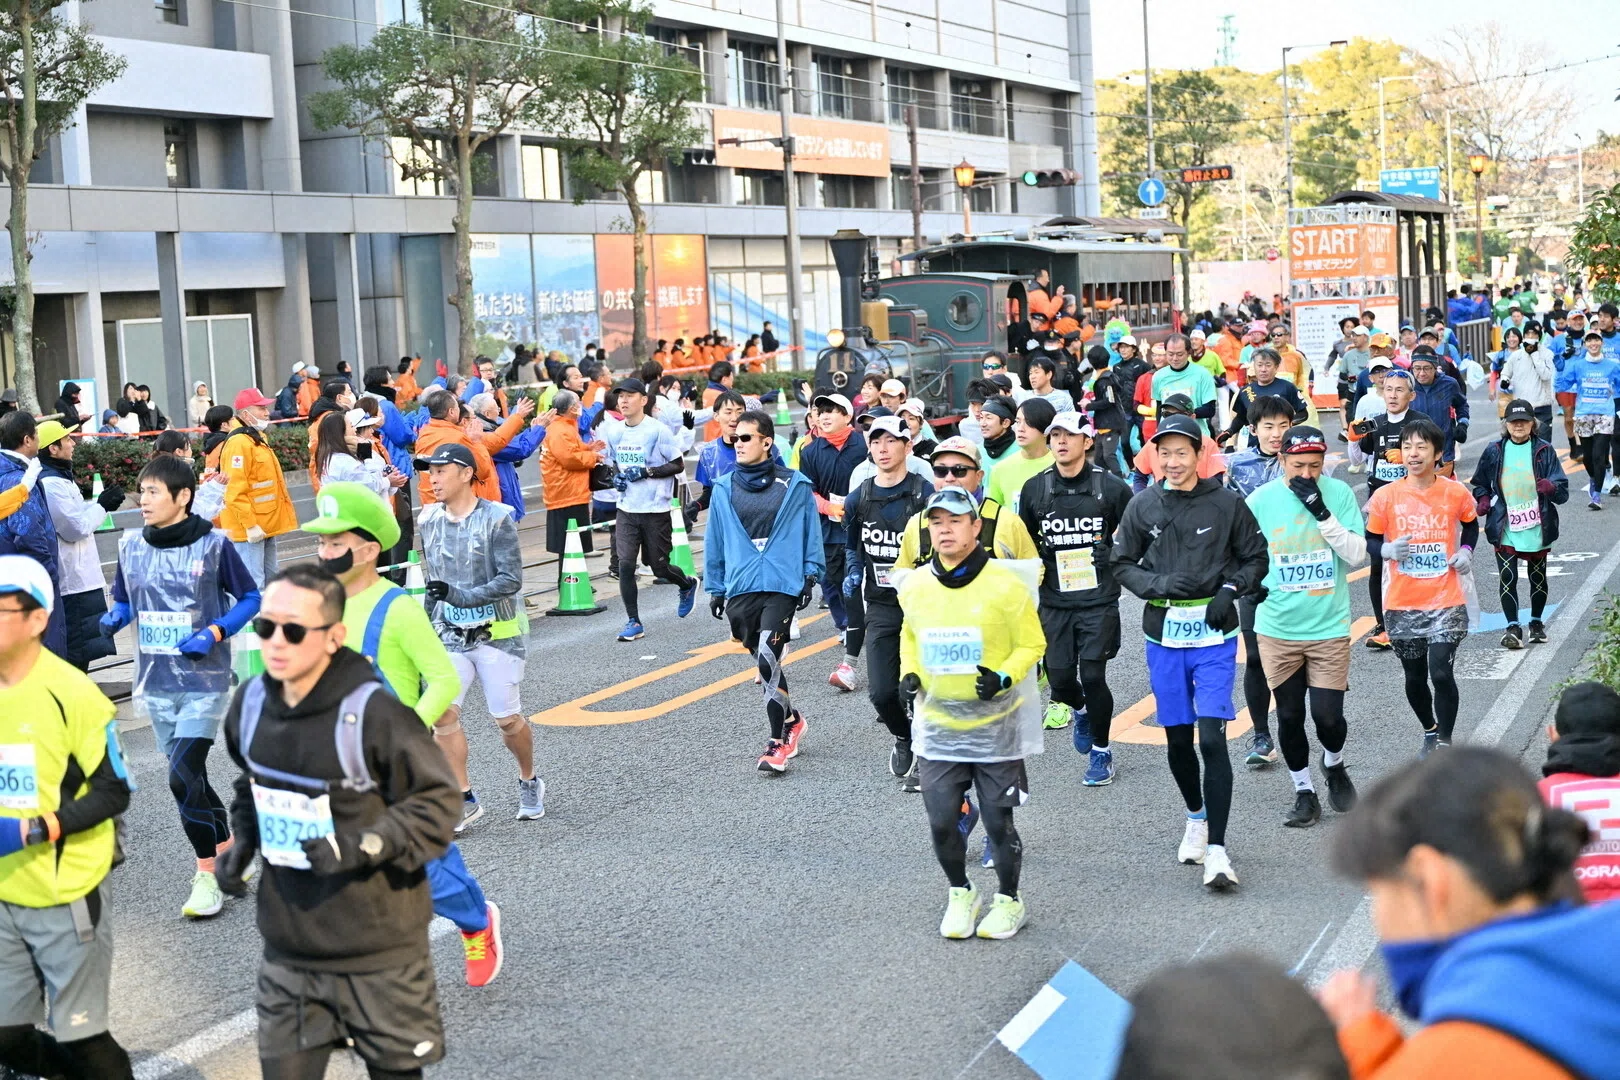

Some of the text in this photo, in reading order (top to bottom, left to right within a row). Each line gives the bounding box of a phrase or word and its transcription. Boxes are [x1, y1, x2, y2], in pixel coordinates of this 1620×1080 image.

[1292, 228, 1358, 256] START
[1367, 226, 1391, 253] START
[474, 293, 526, 317] 私たちは
[538, 290, 595, 313] 新たな価値
[1377, 467, 1408, 478] 18633
[1042, 517, 1103, 534] POLICE
[1395, 514, 1449, 531] OSAKA
[864, 543, 900, 558] 媛県警
[1291, 551, 1327, 562] 伊予銀行
[1279, 564, 1333, 582] 17976G
[447, 605, 494, 621] 18919G
[1167, 620, 1209, 638] 17991
